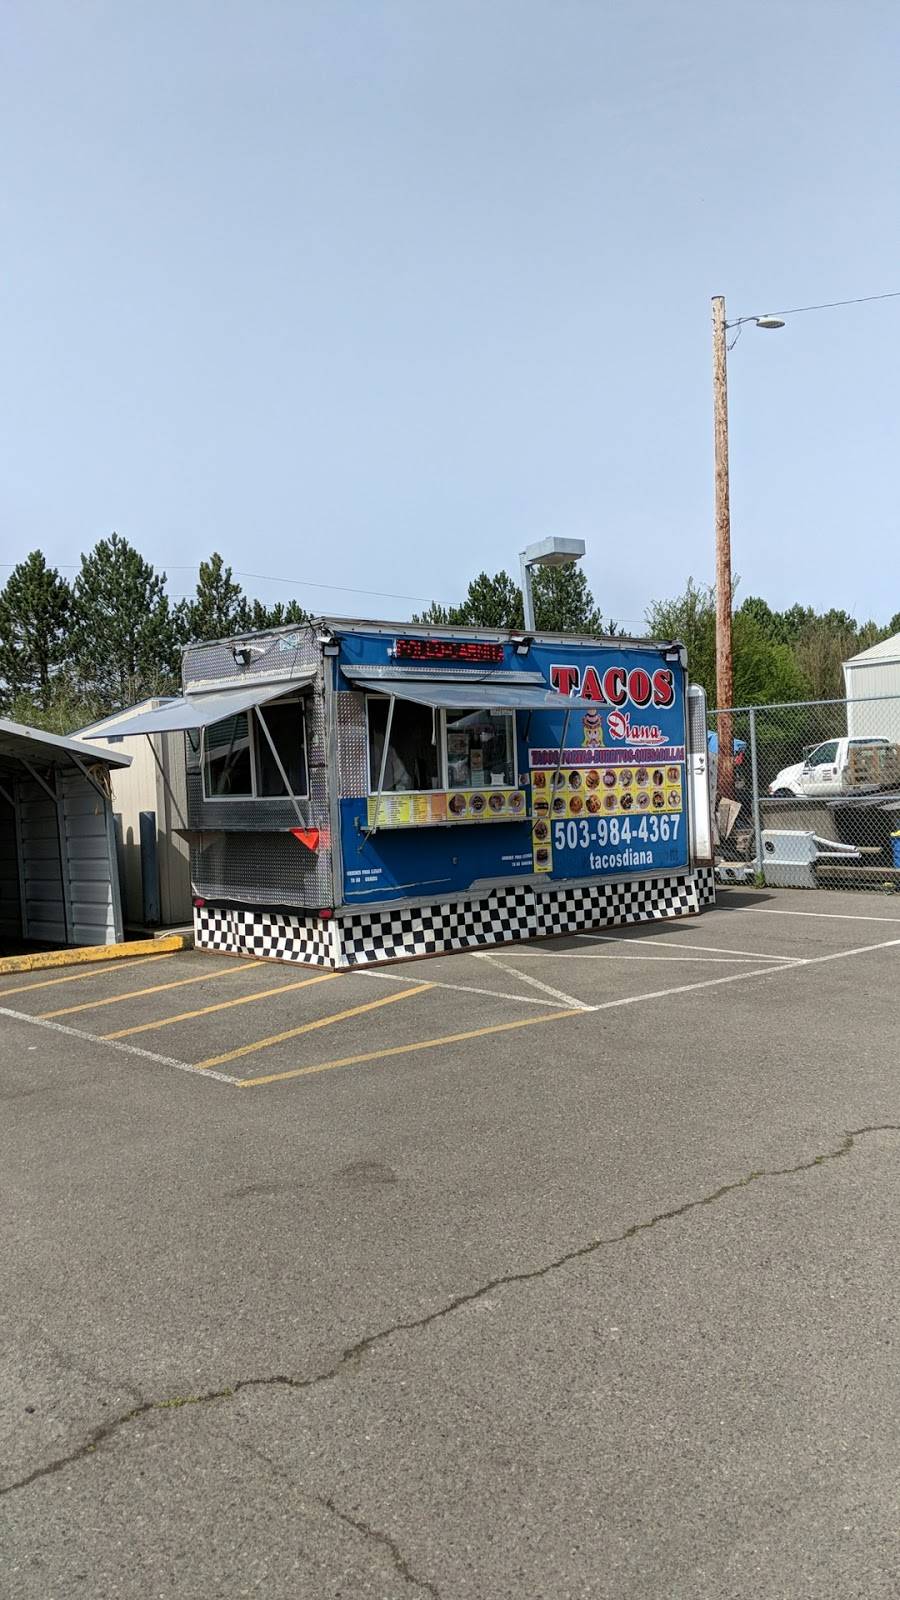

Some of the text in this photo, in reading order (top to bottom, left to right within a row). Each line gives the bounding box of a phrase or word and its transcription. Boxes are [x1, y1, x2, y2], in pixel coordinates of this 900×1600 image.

[550, 665, 675, 710] TACOS
[607, 711, 667, 743] Diana
[555, 814, 680, 850] 503-984-4367
[590, 848, 653, 870] tacosdiana
